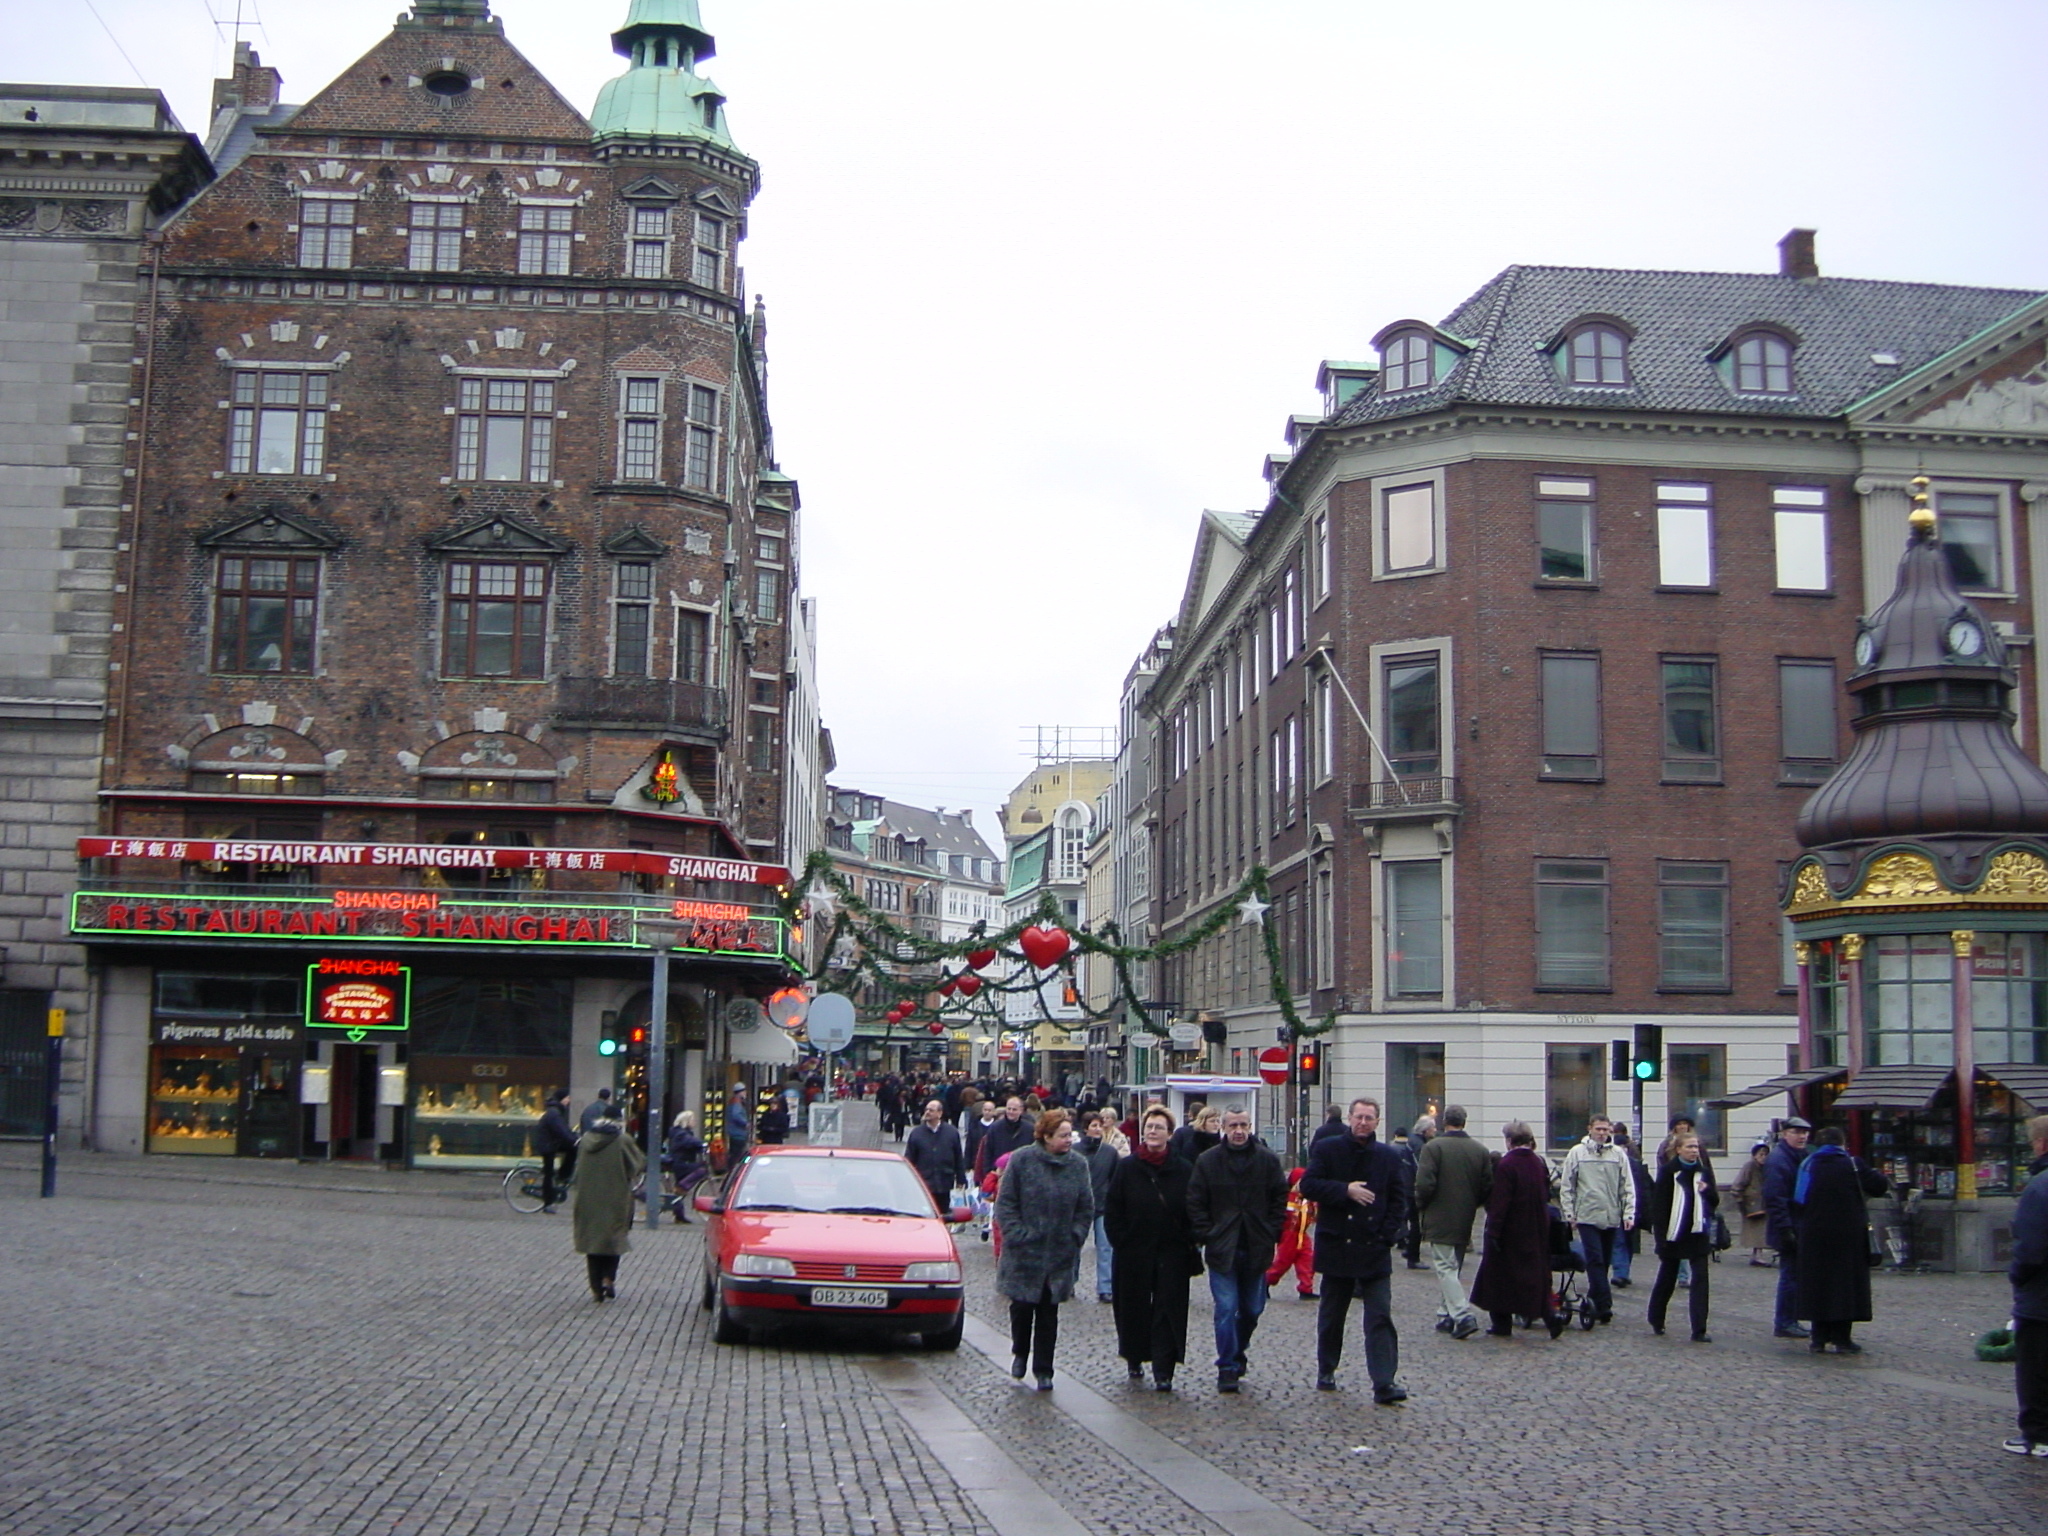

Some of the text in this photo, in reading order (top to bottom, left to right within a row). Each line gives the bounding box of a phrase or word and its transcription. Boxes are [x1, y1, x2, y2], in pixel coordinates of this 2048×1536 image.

[105, 840, 188, 859] 上海飯店
[214, 843, 496, 867] RESTAURANT SHANGHAI
[524, 851, 606, 870] 上海飯店
[668, 857, 758, 883] SHANGHAI
[333, 890, 438, 911] SHANGHAI
[675, 900, 750, 921] SHANGHAI
[106, 904, 609, 941] RESTAURANT SHANGHAI
[318, 958, 400, 976] SHANGHAI
[1557, 1015, 1596, 1024] NYTORV
[814, 1290, 885, 1306] OB 23 405
